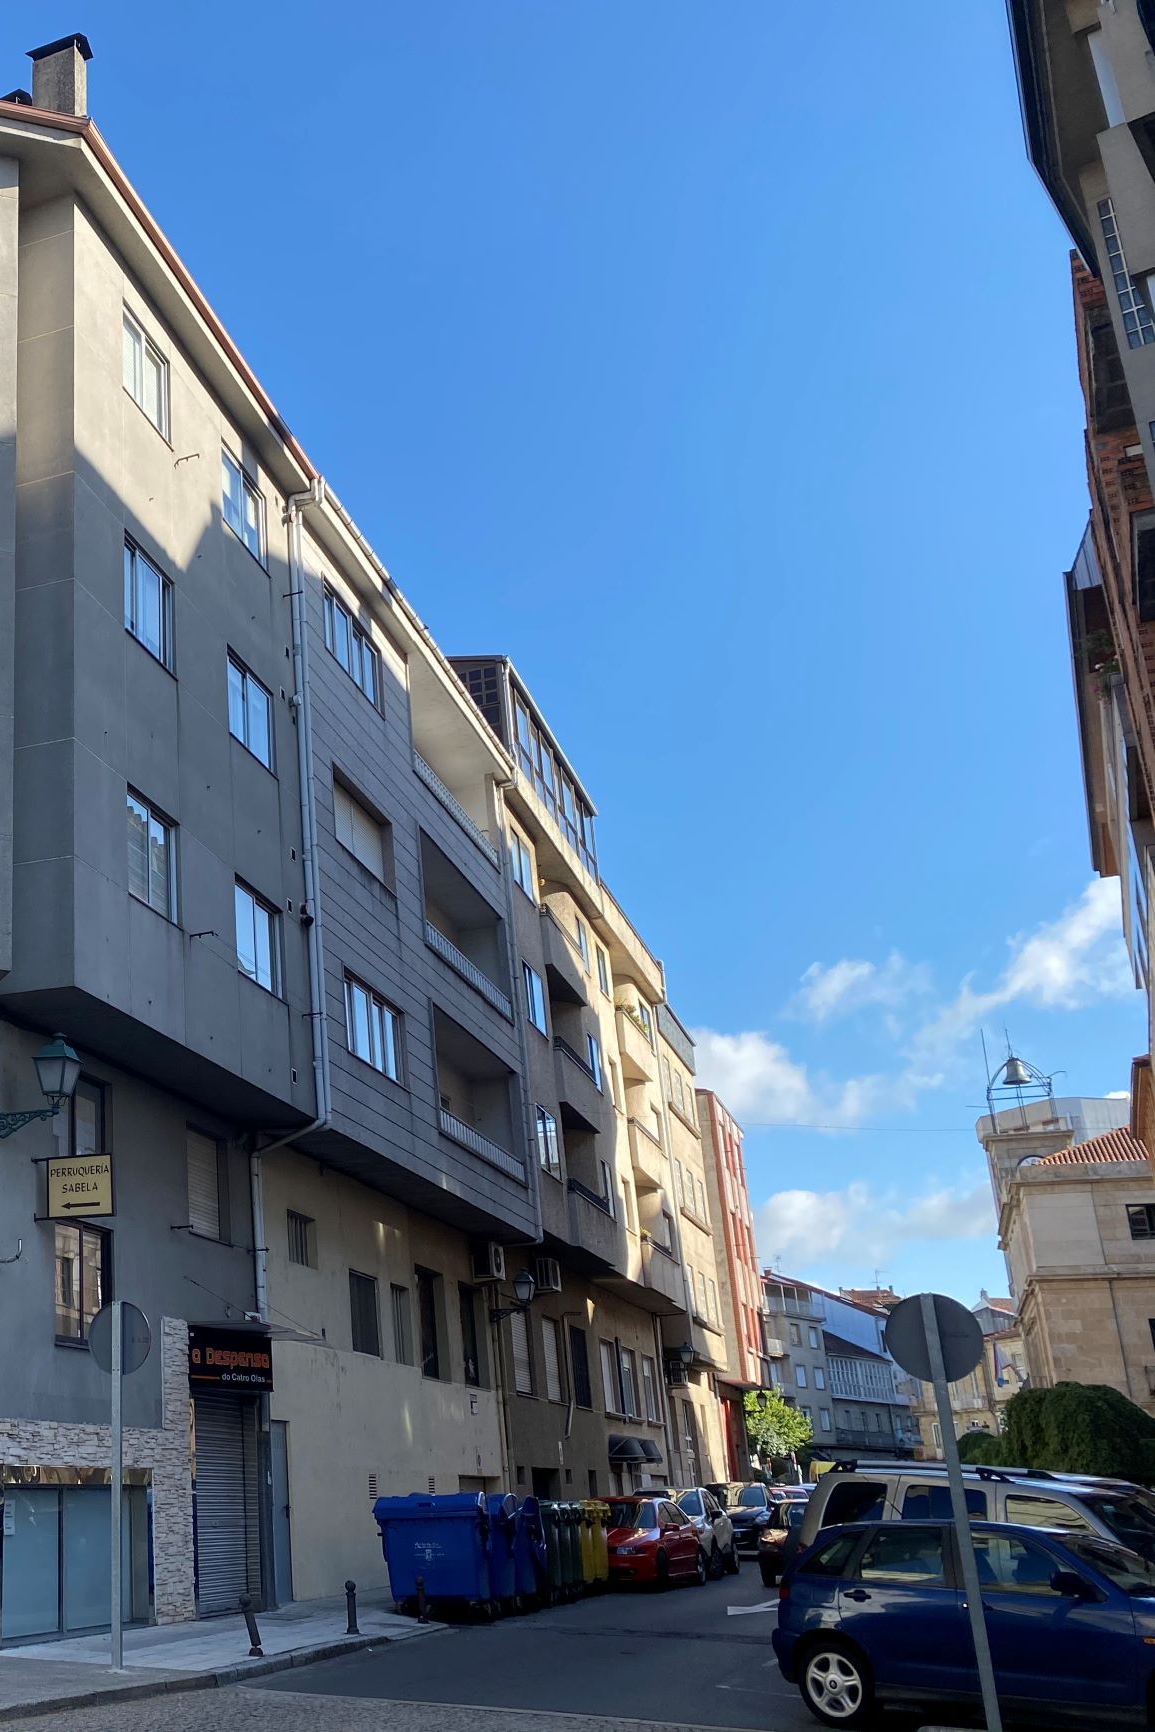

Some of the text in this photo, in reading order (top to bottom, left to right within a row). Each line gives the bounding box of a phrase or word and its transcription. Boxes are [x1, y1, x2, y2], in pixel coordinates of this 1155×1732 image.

[50, 1163, 109, 1177] PERRUQUERÍA
[62, 1182, 98, 1193] SABELA
[206, 1347, 270, 1369] Despensa
[222, 1373, 231, 1381] do
